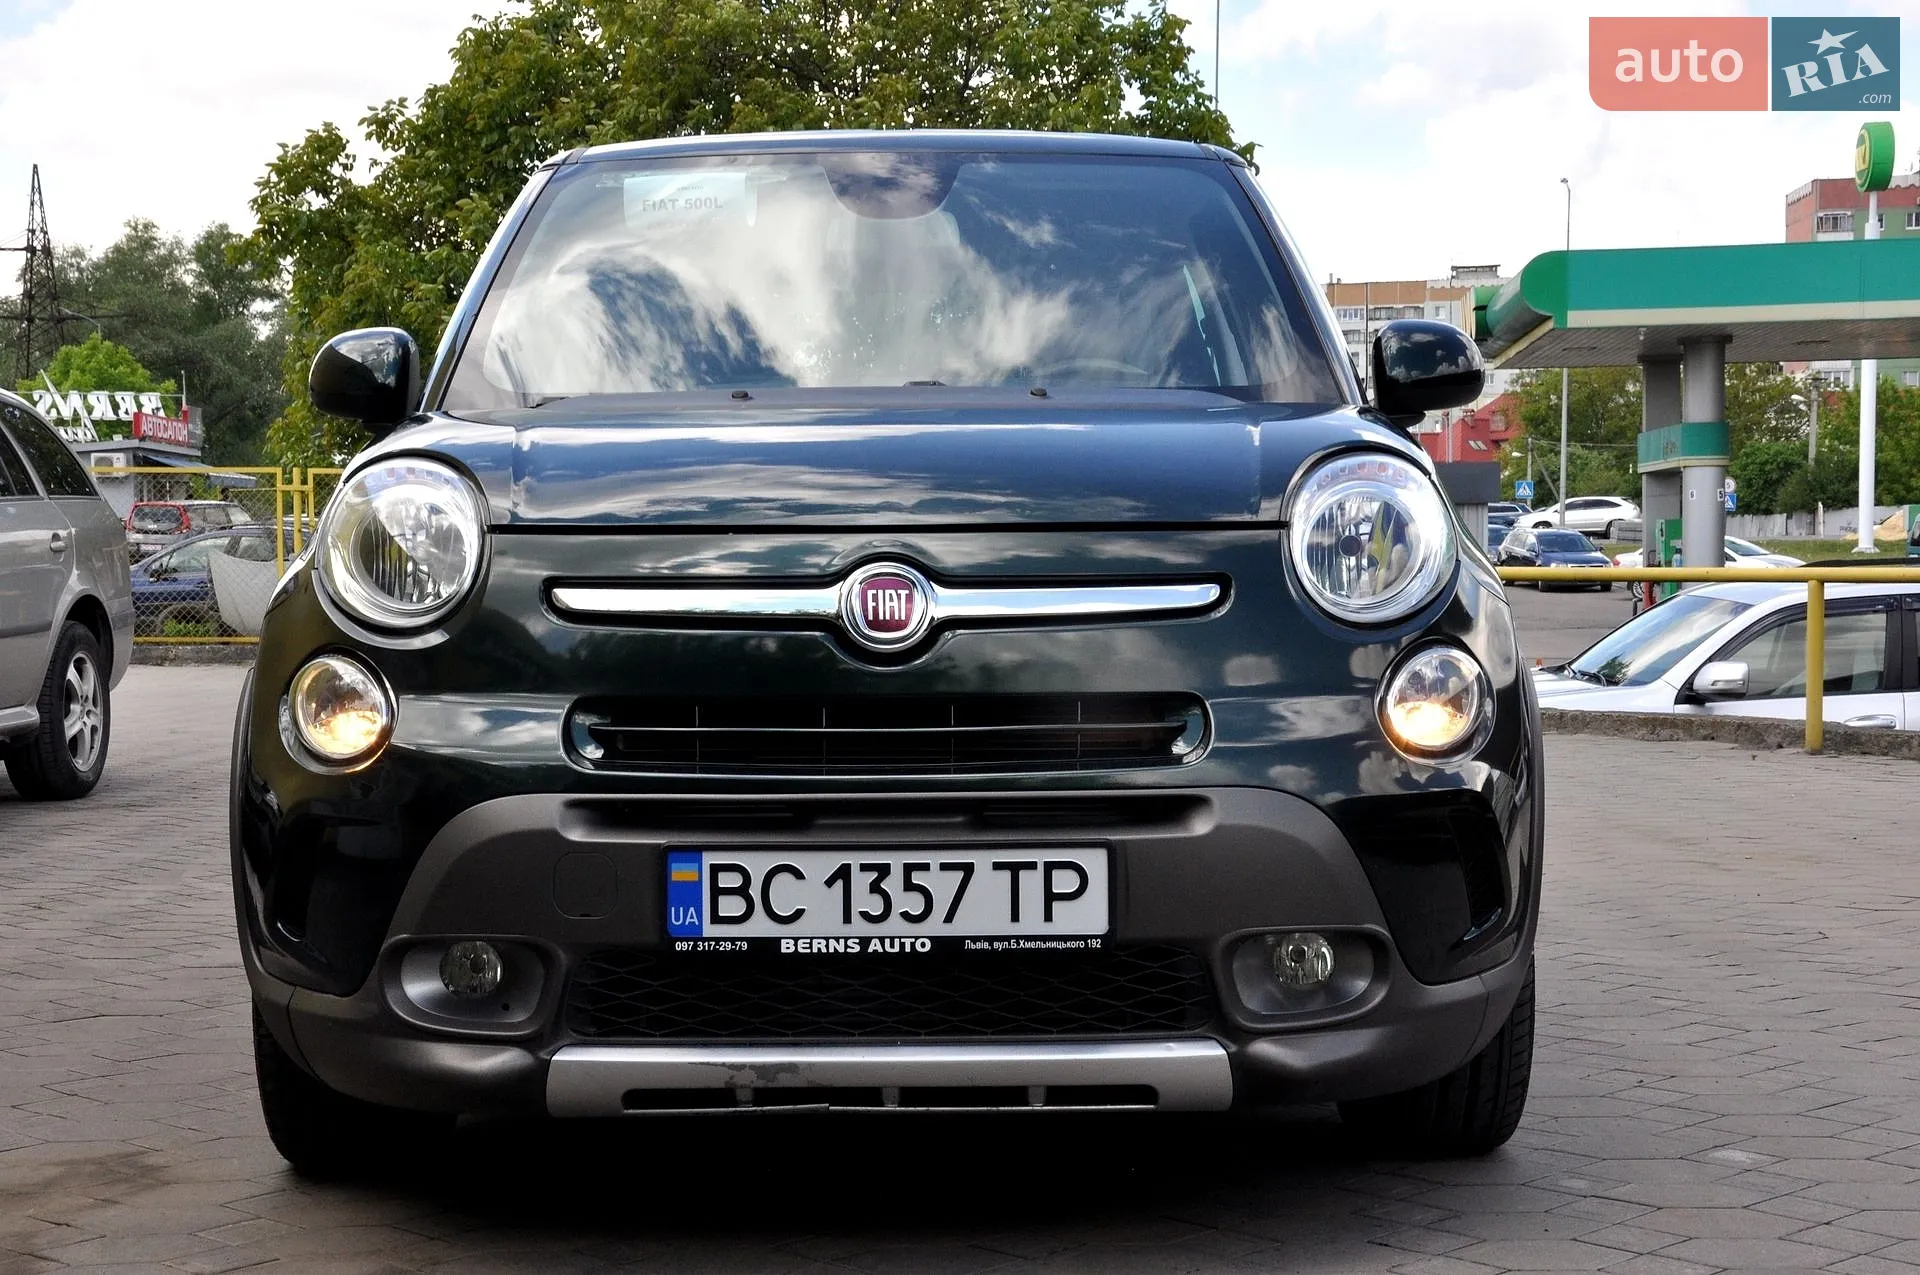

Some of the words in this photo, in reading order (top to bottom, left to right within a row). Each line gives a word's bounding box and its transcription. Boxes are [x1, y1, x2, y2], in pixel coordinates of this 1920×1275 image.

[141, 415, 188, 443] АВТОСАЛОН
[867, 590, 910, 620] FIAT
[709, 862, 807, 925] BC
[824, 861, 975, 924] 1357
[992, 860, 1089, 923] TP
[671, 907, 699, 925] UA
[675, 942, 694, 951] 097
[697, 942, 748, 951] 317-29-79
[780, 938, 860, 953] BERNS
[868, 938, 931, 953] AUTO
[965, 940, 991, 950] Львів,
[994, 939, 1085, 951] вул.Б.Хмельницького
[1087, 939, 1101, 948] 192
